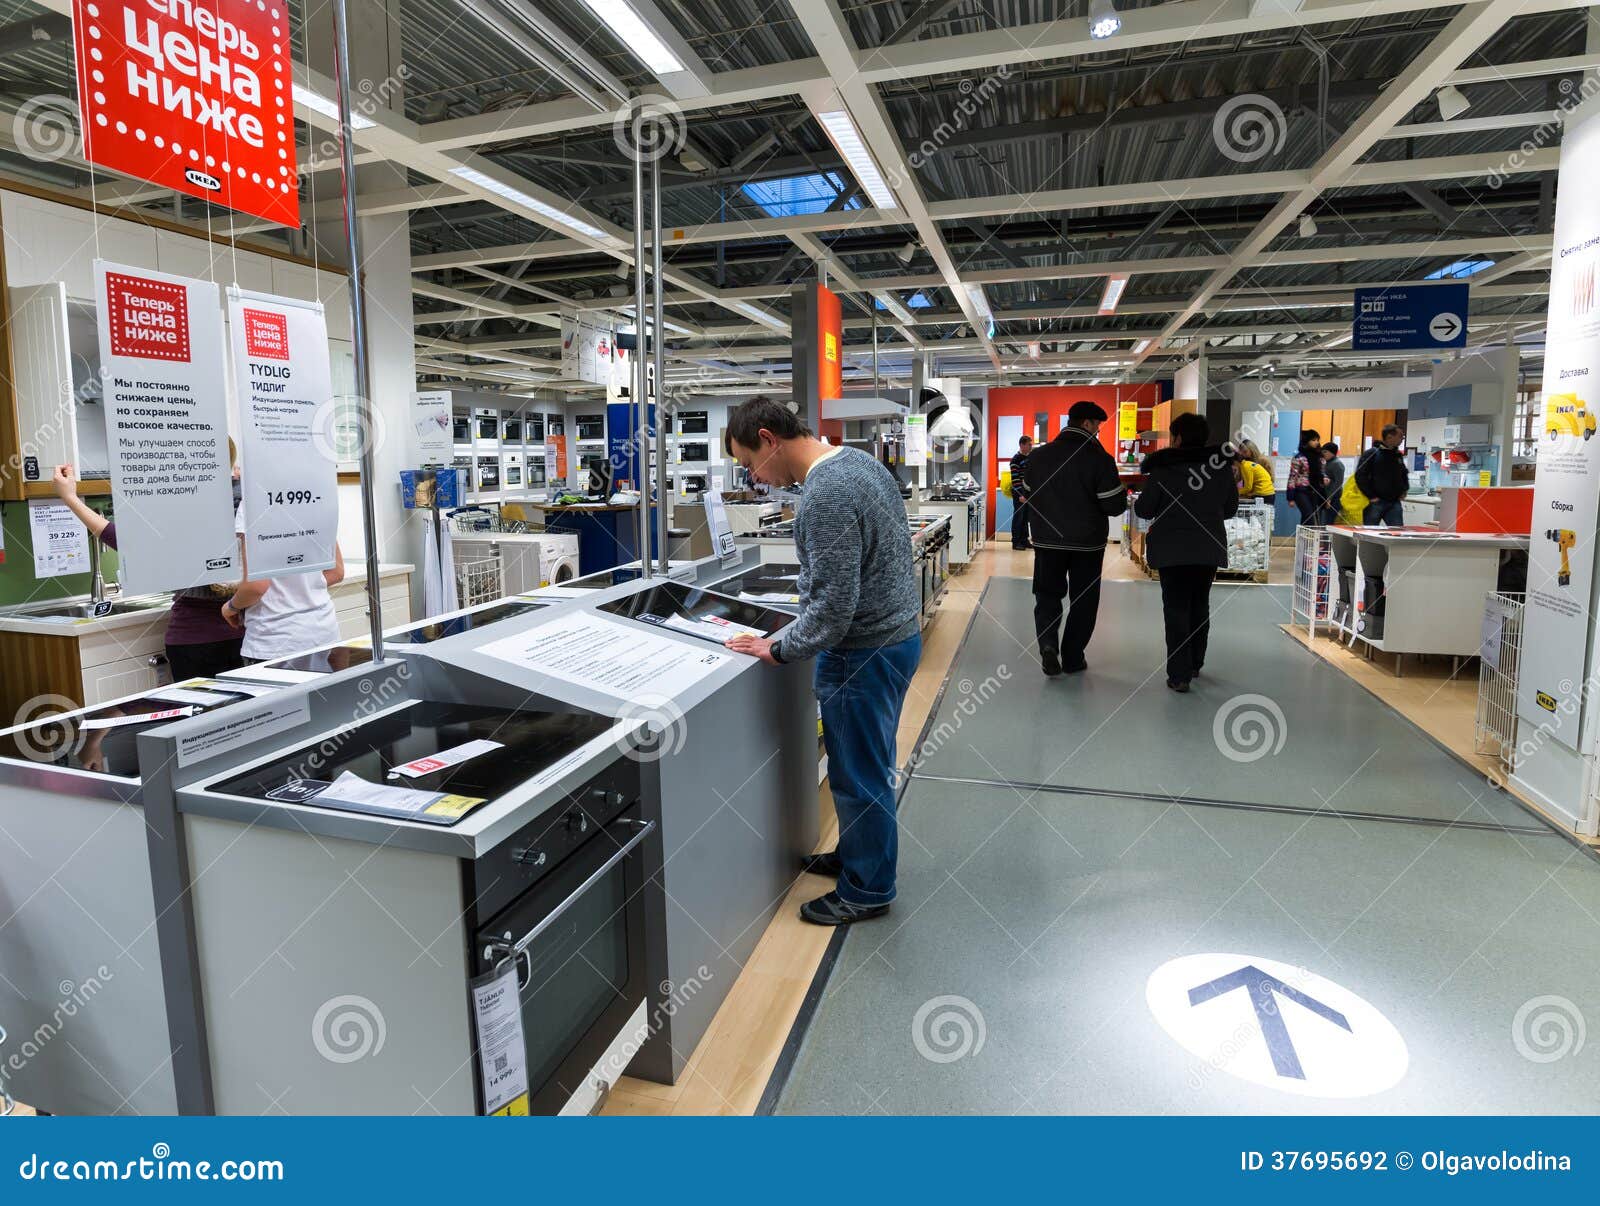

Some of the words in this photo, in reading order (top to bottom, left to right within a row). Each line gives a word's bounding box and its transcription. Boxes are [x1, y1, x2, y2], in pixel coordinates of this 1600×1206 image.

[146, 0, 259, 61] еперь
[124, 7, 262, 108] цена
[126, 60, 264, 148] ниже
[190, 172, 217, 187] IKEA
[121, 291, 175, 313] Теперь
[124, 308, 176, 329] цена
[252, 319, 280, 331] Теперь
[125, 326, 177, 344] ниже
[253, 329, 281, 340] цена
[254, 339, 282, 350] ниже
[249, 363, 291, 378] TYDLIG
[1560, 367, 1589, 379] Доставка
[114, 378, 132, 388] Мы
[136, 381, 190, 392] постоянно
[250, 381, 286, 392] ТИДЛИГ
[115, 393, 164, 403] снижаем
[167, 397, 196, 406] цены,
[116, 407, 130, 415] но
[133, 408, 189, 418] сохраняем
[1556, 405, 1574, 414] IKEA
[118, 421, 164, 430] высокое
[167, 422, 213, 431] качество.
[119, 438, 134, 448] Мы
[138, 440, 184, 449] улучшаем
[186, 438, 216, 448] способ
[120, 451, 187, 461] производства,
[190, 450, 216, 459] чтобы
[121, 463, 156, 473] товары
[158, 463, 175, 472] для
[178, 461, 220, 471] обустрой-
[122, 475, 144, 485] ства
[147, 475, 170, 484] дома
[172, 473, 195, 483] были
[198, 473, 216, 482] дос-
[123, 488, 154, 498] тупны
[156, 485, 198, 496] каждому!
[268, 492, 284, 506] 14
[287, 490, 321, 505] 999.-
[1551, 500, 1574, 512] Сборка
[61, 531, 80, 540] 229.-
[182, 725, 226, 745] Индукционная
